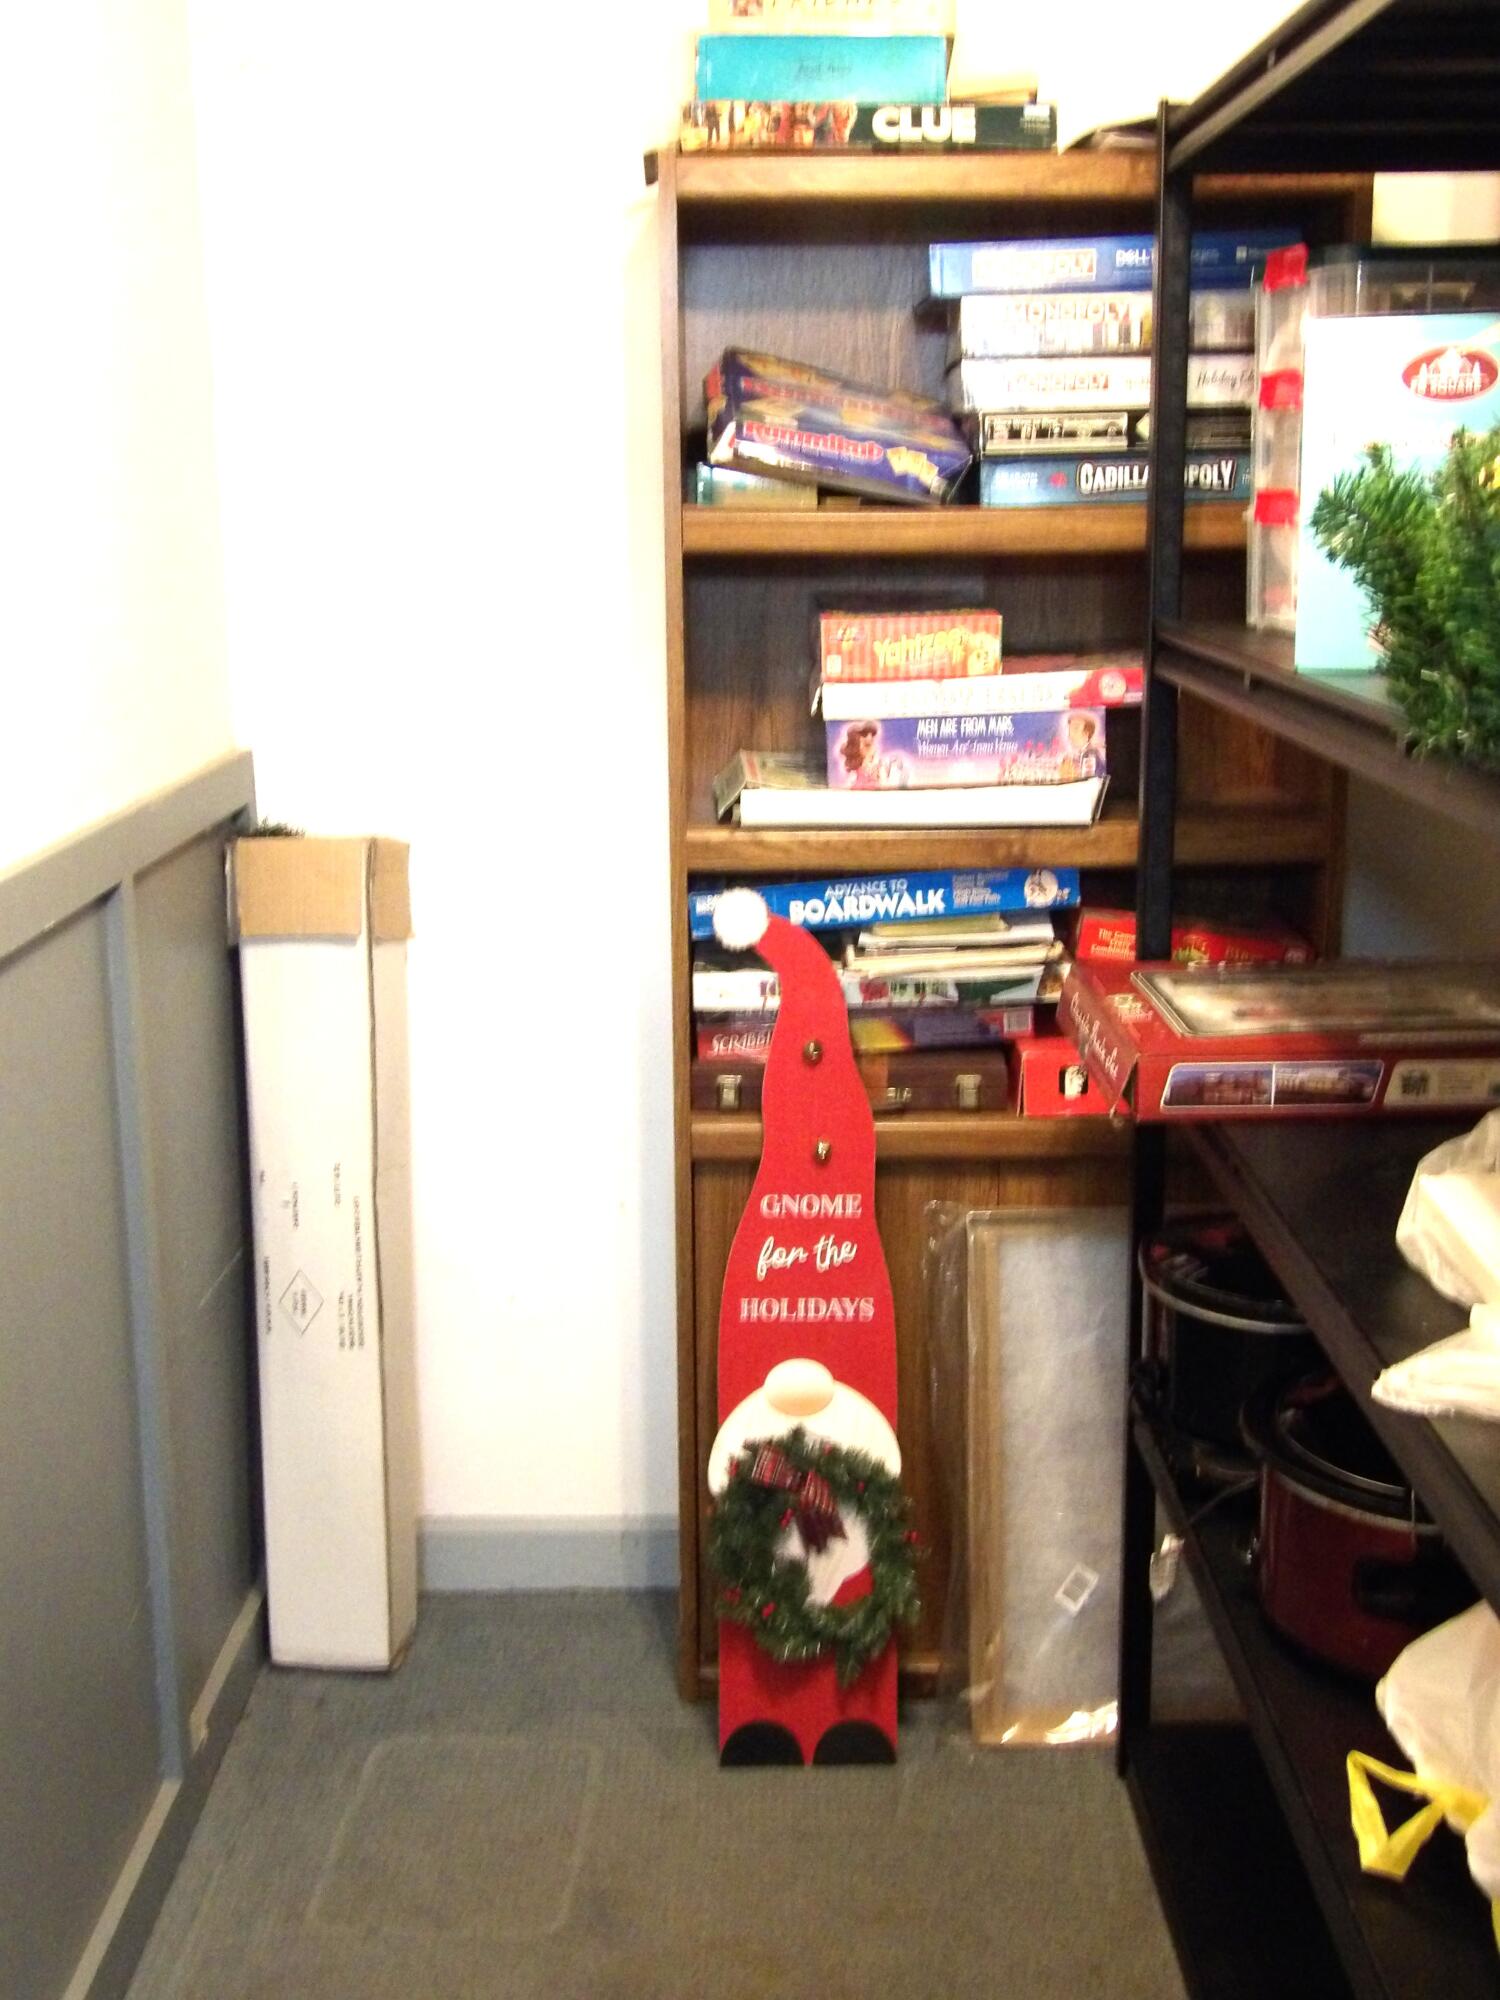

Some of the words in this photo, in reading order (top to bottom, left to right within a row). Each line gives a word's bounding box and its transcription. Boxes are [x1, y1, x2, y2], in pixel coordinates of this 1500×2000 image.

[872, 105, 976, 144] CLUE
[1195, 368, 1238, 391] Holiday
[1079, 459, 1235, 493] CADILLAPOLY
[916, 717, 938, 737] MEN
[940, 717, 958, 737] ARE
[960, 716, 986, 737] FROM
[825, 880, 887, 900] ADVANCE
[889, 878, 909, 893] TO
[789, 888, 945, 926] BOARDWALK
[711, 1031, 771, 1057] SCRABBL
[760, 1193, 862, 1219] GNOME
[756, 1235, 810, 1282] for
[813, 1233, 858, 1273] the
[739, 1297, 875, 1323] HOLIDAYS
